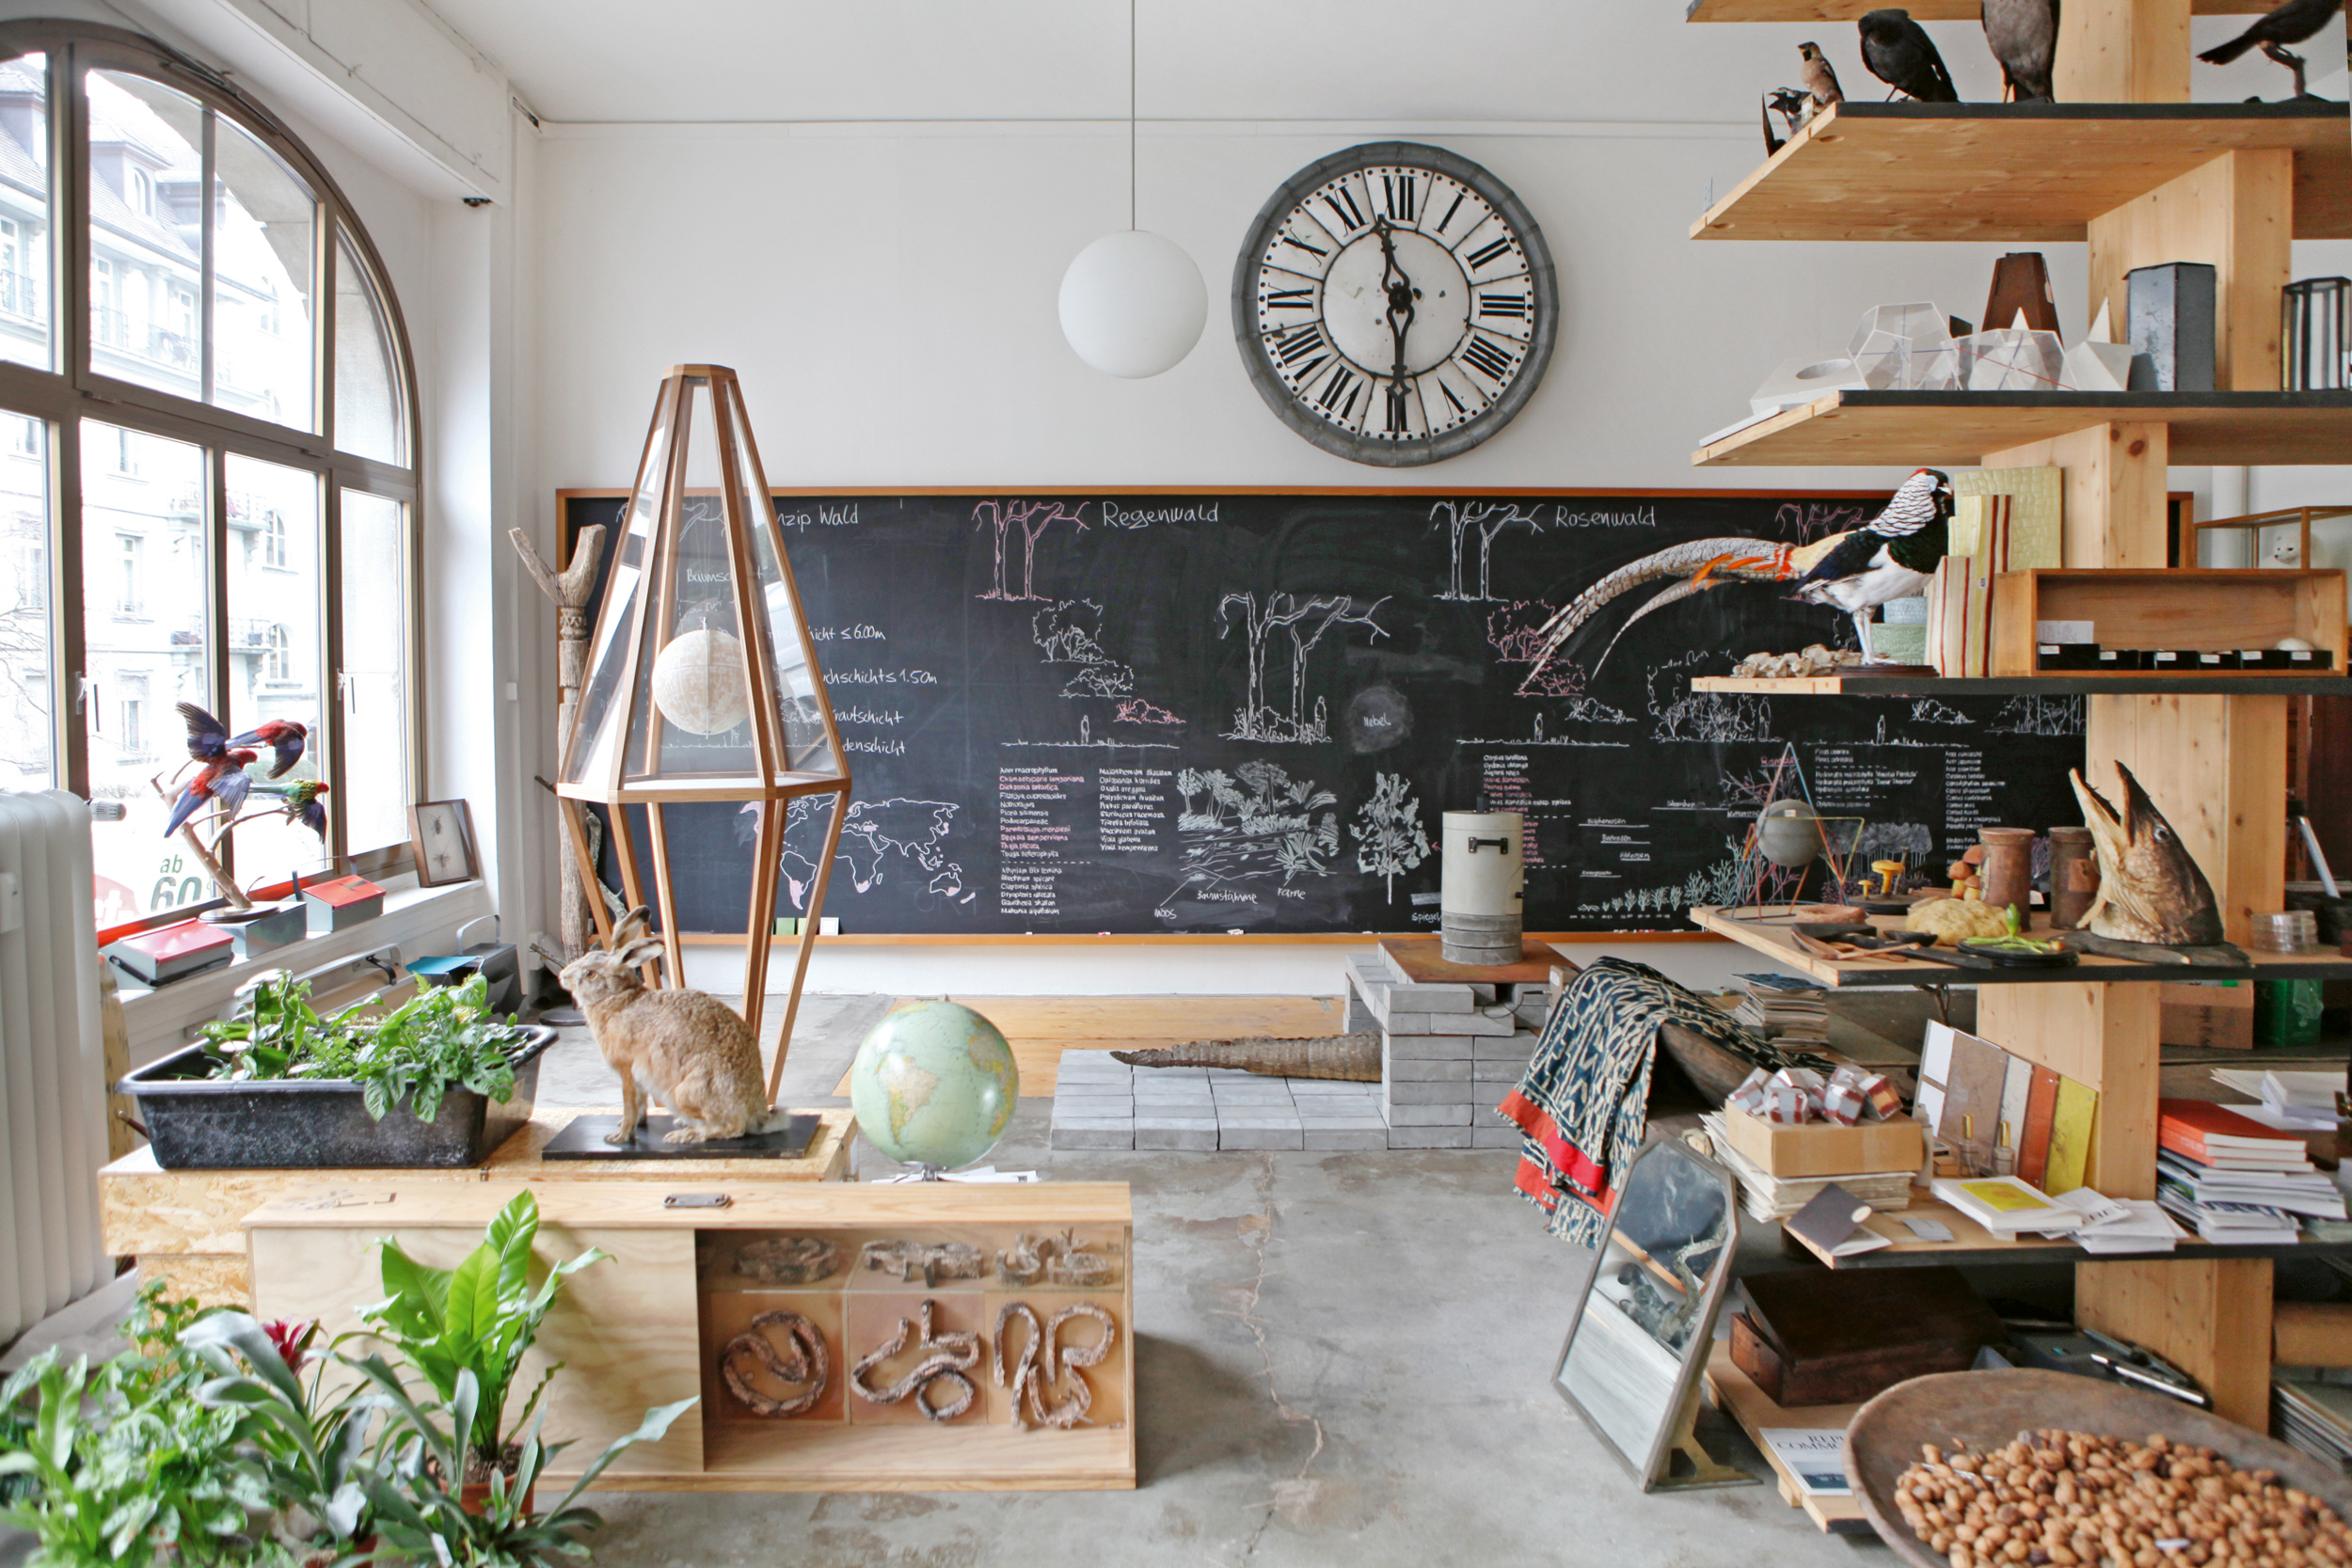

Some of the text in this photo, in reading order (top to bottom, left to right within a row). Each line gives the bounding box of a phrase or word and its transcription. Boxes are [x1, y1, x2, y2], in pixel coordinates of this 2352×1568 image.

[1320, 184, 1369, 237] XI
[1380, 175, 1417, 222] XII
[1434, 191, 1468, 235] I
[1281, 228, 1330, 266] X
[1465, 234, 1516, 274] II
[1267, 282, 1314, 312] IX
[1479, 292, 1526, 320] III
[1275, 324, 1331, 383] VIII
[1460, 331, 1515, 384] IIII
[1315, 363, 1364, 420] VII
[1438, 377, 1470, 420] V
[819, 503, 858, 526] Wald
[1103, 500, 1218, 530] Regenwald
[1556, 505, 1656, 527] Rosenwald
[899, 669, 938, 685] 1.50m
[832, 705, 904, 726] rautschicht
[1363, 712, 1391, 727] Nebel
[160, 854, 183, 874] ab
[1278, 888, 1306, 900] Farne
[1807, 1434, 1843, 1443] REP
